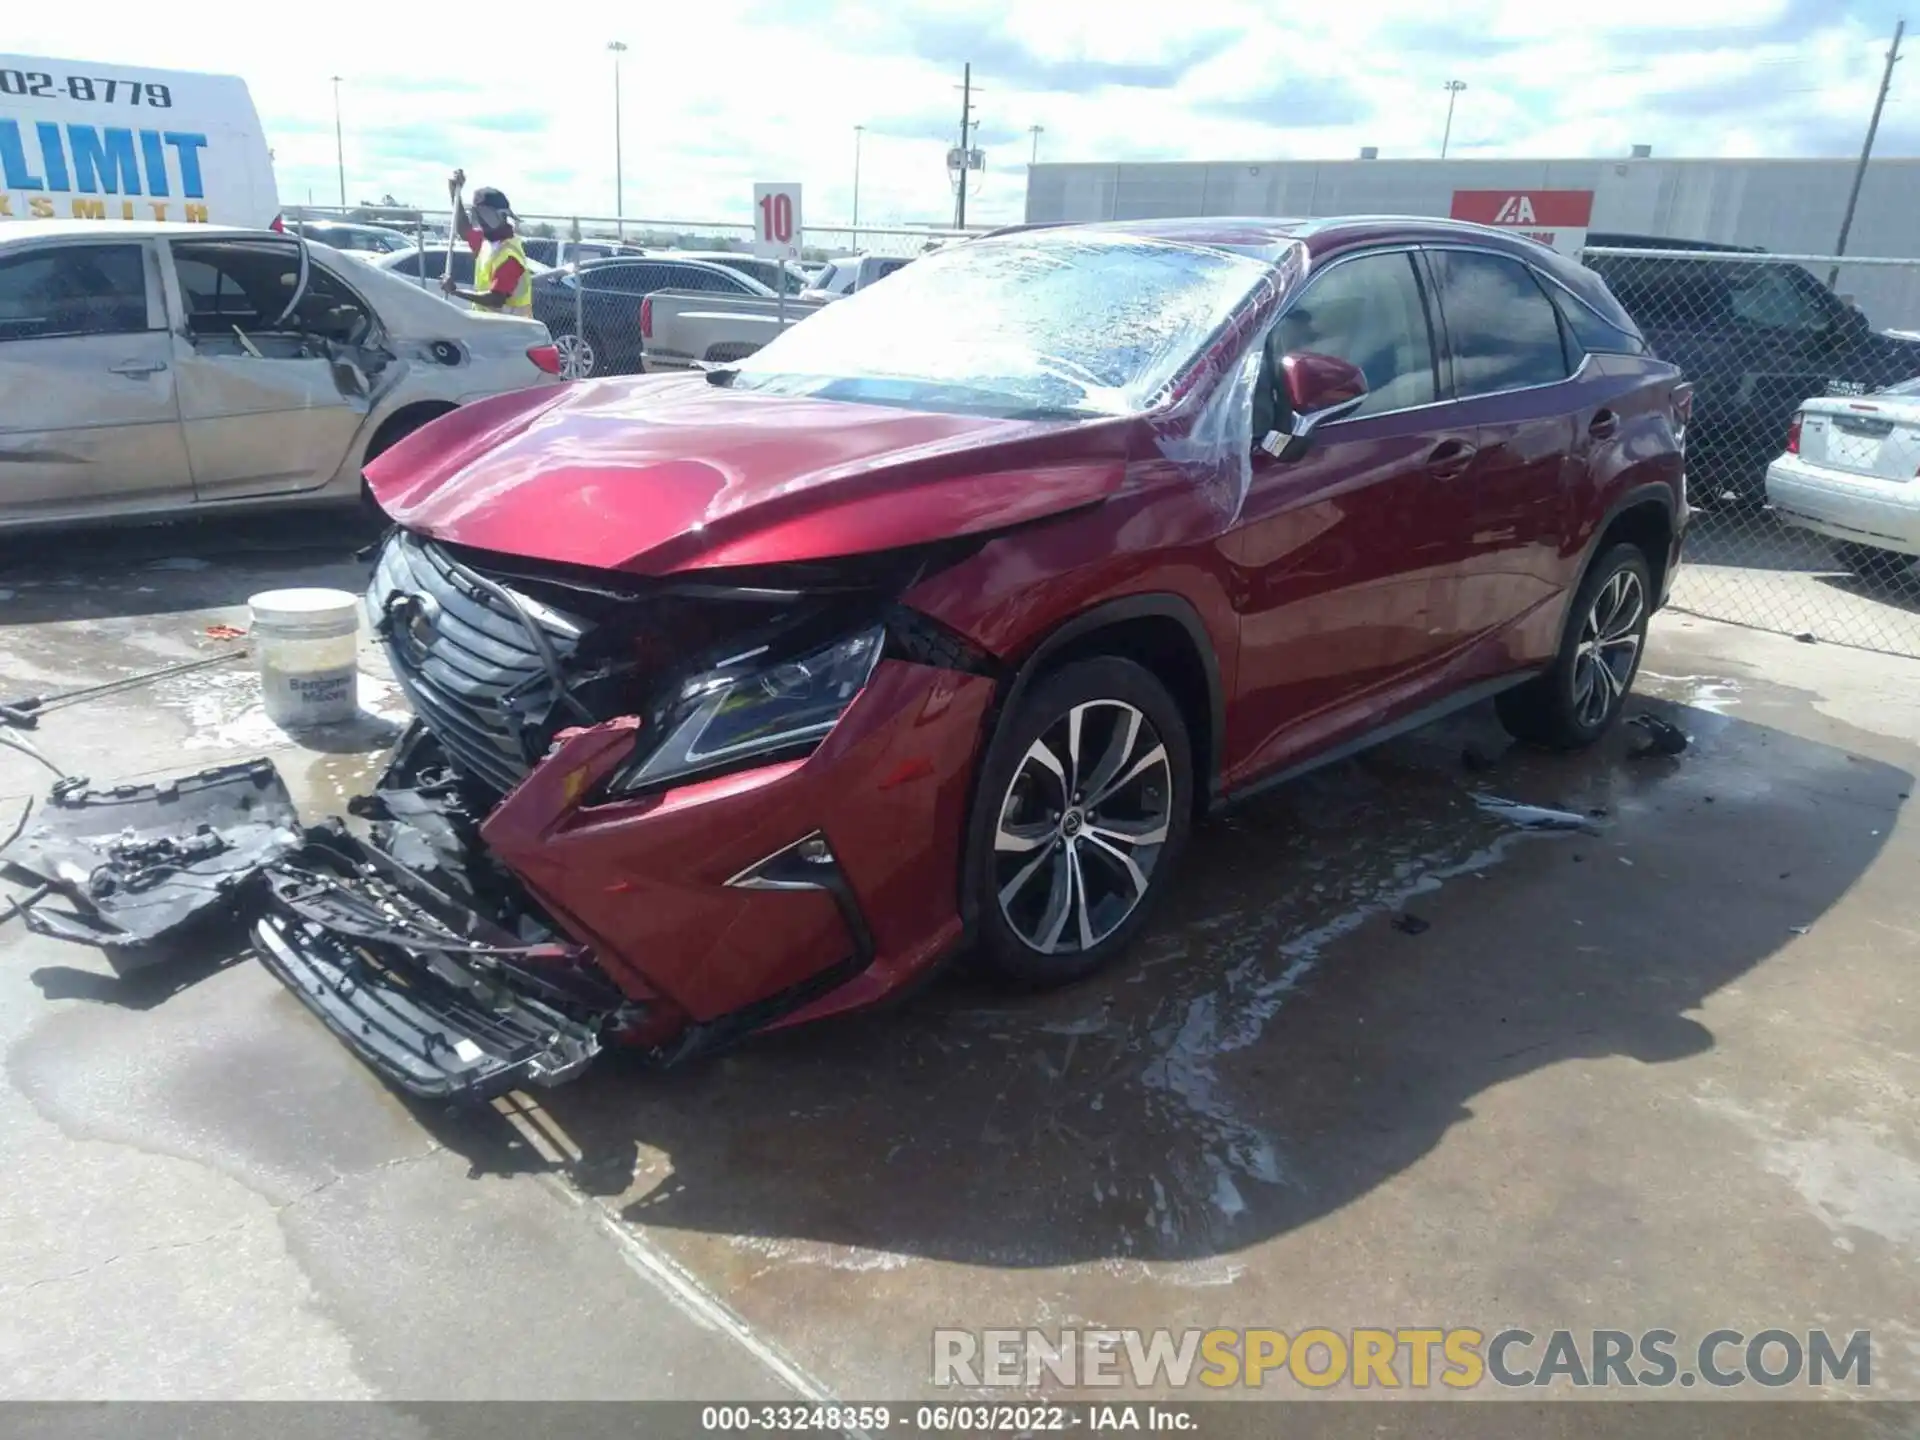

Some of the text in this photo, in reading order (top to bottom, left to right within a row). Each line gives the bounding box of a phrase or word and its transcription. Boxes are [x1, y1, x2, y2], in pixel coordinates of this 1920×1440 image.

[0, 69, 172, 108] 02-8779
[0, 117, 208, 199] LIMIT
[759, 193, 792, 244] 10
